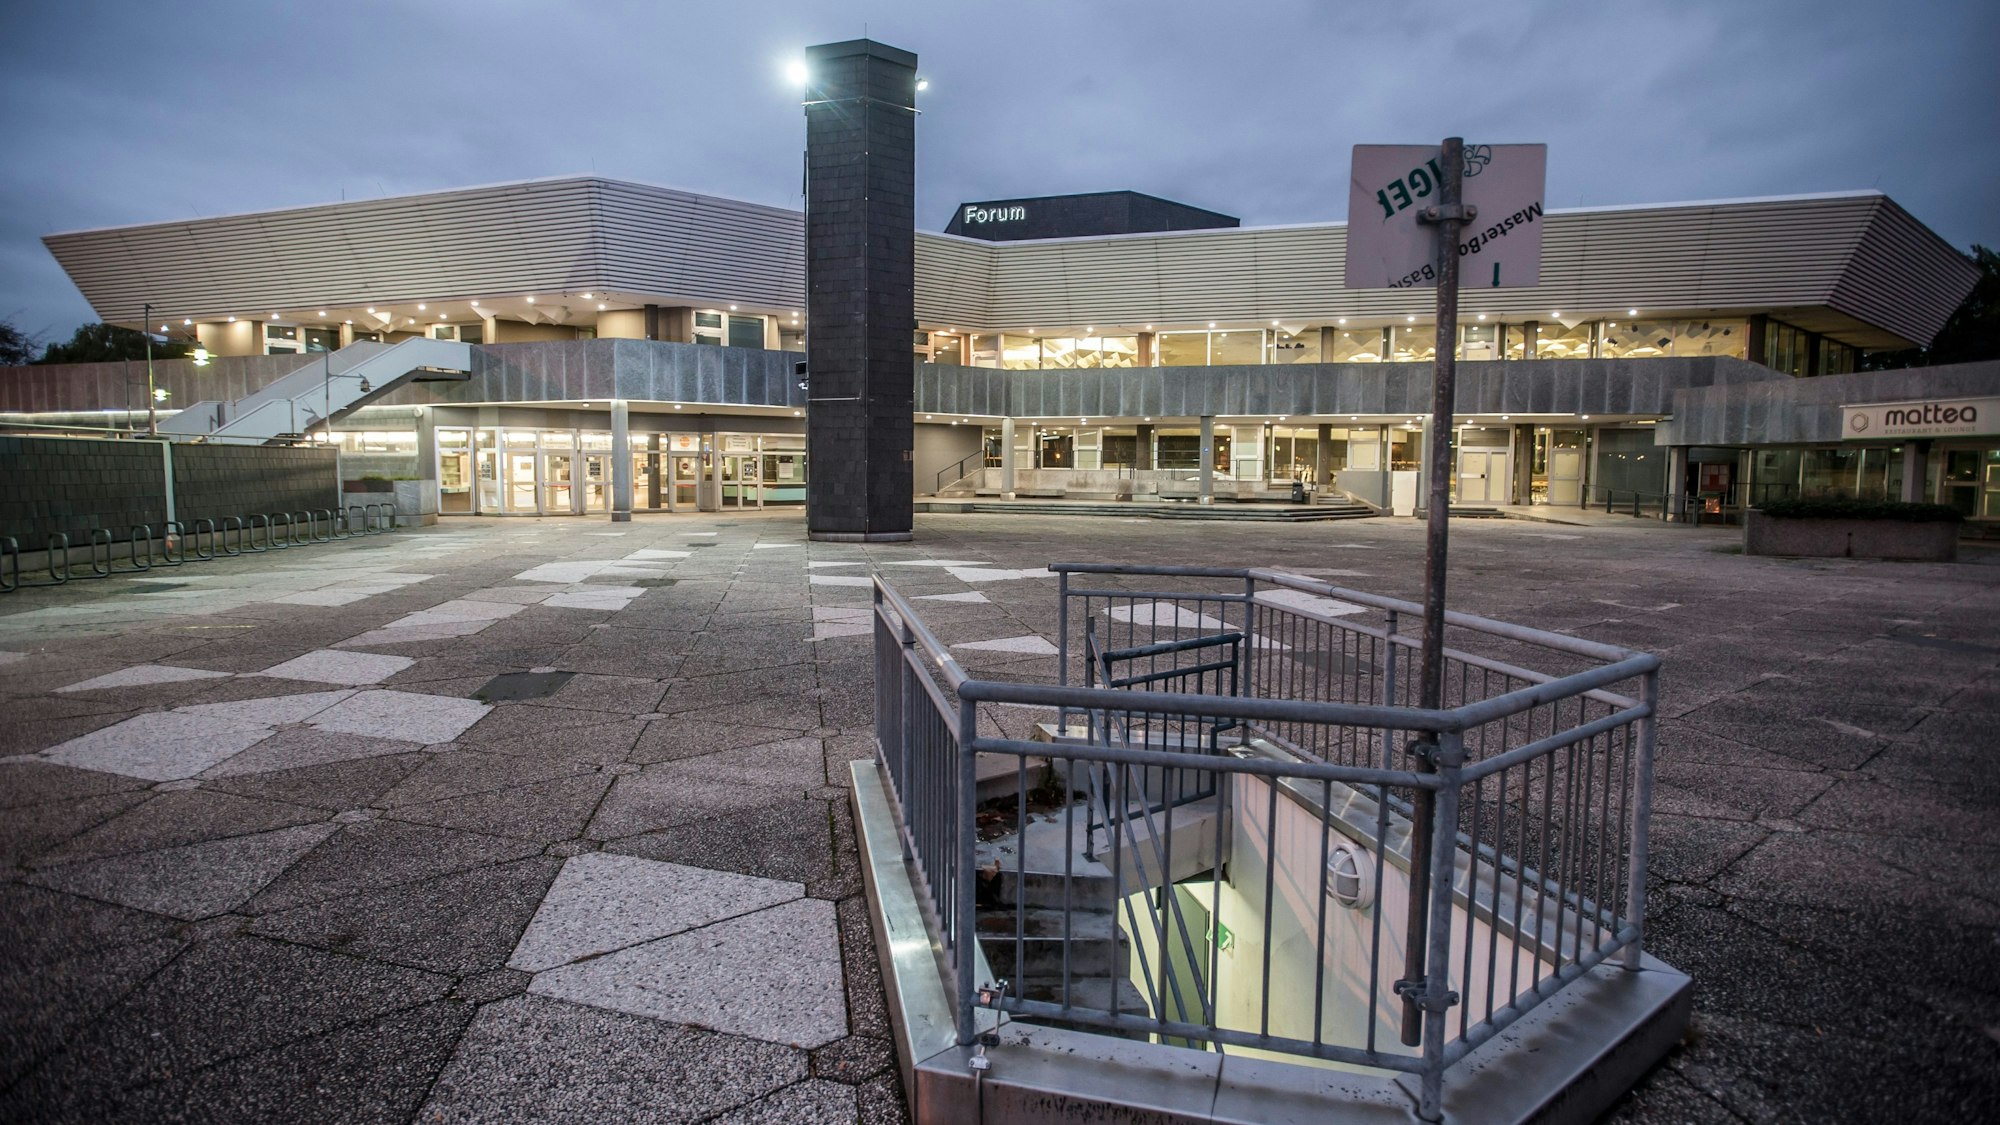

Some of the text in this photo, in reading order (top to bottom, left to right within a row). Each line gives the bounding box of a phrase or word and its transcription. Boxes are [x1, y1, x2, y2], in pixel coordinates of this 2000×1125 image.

[965, 205, 1025, 224] Forum
[1459, 202, 1543, 256] MasterBo
[1885, 404, 1977, 426] mattea
[1884, 427, 1932, 435] RESTAURANT
[1943, 425, 1976, 433] LOUNGE
